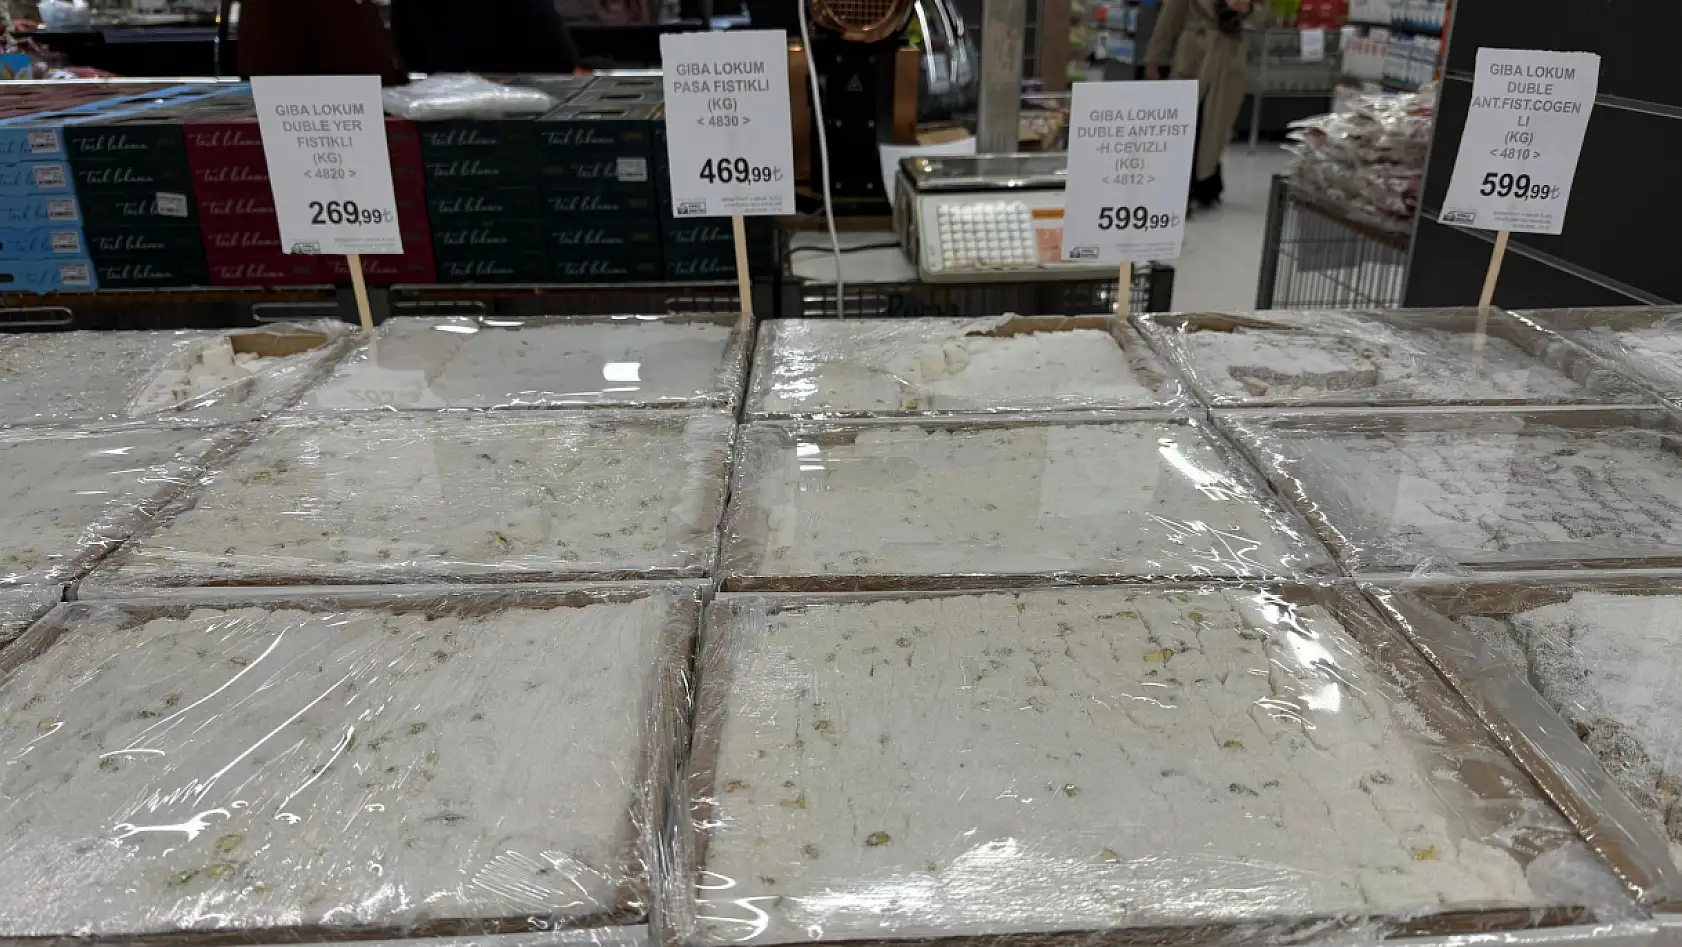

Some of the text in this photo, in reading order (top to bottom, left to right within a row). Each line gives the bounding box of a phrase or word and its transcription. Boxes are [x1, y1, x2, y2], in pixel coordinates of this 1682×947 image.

[676, 62, 765, 76] GIBA LOKUM
[1489, 63, 1575, 80] GIBA LOKUM
[714, 79, 770, 93] FISTIKLI
[1507, 81, 1553, 95] DUBLE
[275, 104, 364, 116] GIBA LOKUM
[708, 98, 737, 112] (KG)
[1472, 97, 1582, 114] ANT.FIST.COGEN
[708, 115, 739, 127] 4830
[1089, 108, 1178, 121] GIBA LOKUM
[282, 120, 363, 132] DUBLE YER
[1518, 116, 1530, 127] LI
[1078, 124, 1189, 138] DUBLE ANT.FIST
[297, 136, 352, 148] FISTIKLI
[1504, 131, 1534, 146] (KG)
[1096, 141, 1167, 154] -H.CEVIZLI
[313, 152, 342, 166] (KG)
[1500, 149, 1530, 160] 4810
[1115, 158, 1144, 170] (KG)
[315, 168, 345, 179] 4820
[1113, 174, 1144, 185] 4812
